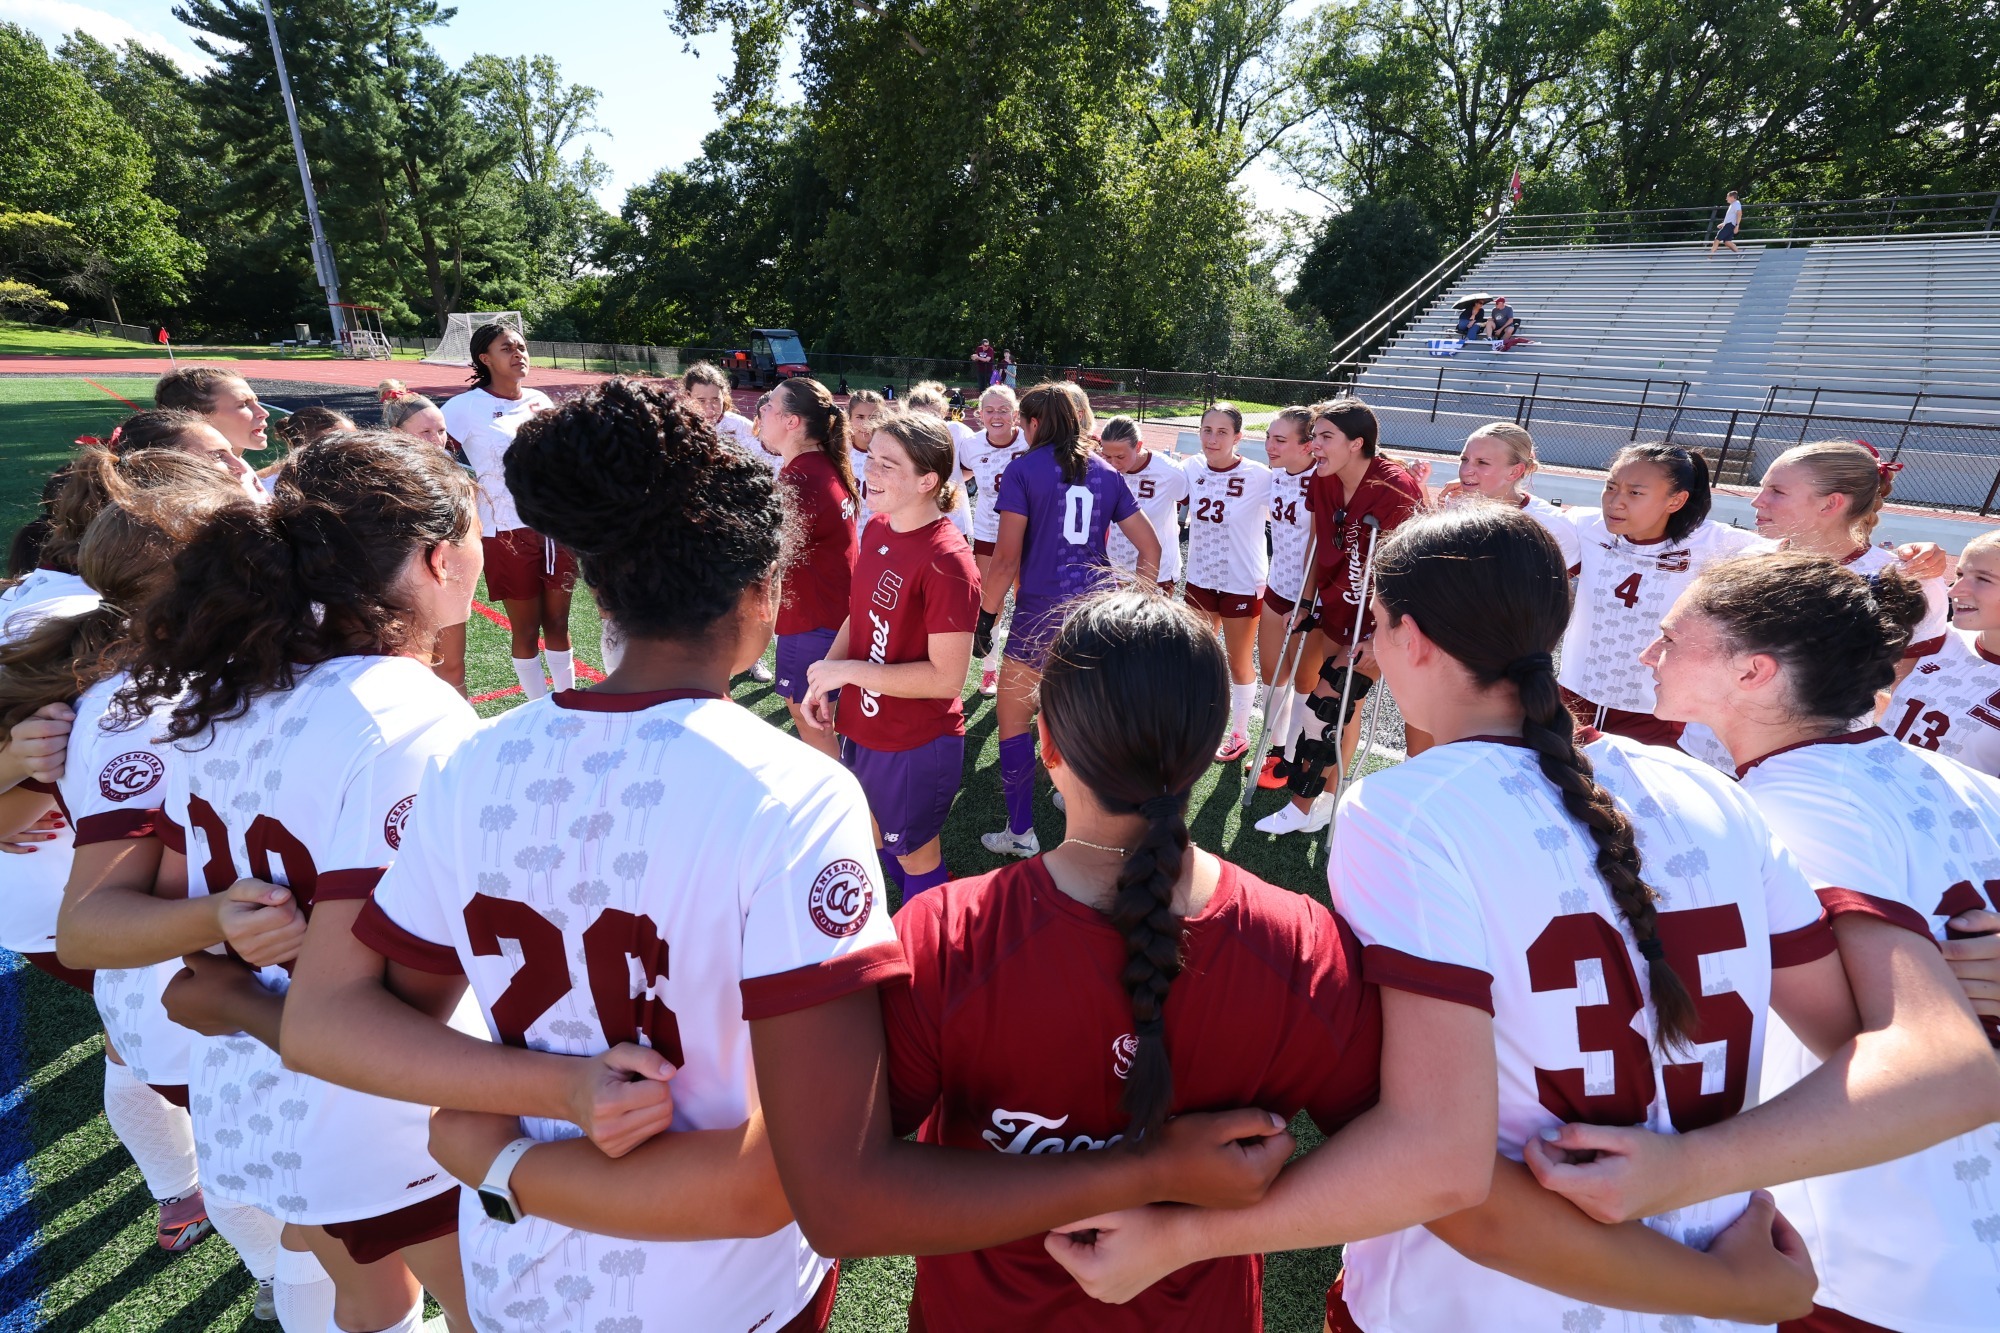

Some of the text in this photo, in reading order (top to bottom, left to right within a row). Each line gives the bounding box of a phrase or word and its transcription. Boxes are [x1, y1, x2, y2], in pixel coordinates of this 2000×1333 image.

[1137, 479, 1157, 499] S
[1225, 476, 1246, 498] S
[1063, 484, 1094, 545] 0
[1196, 497, 1226, 524] 23
[1272, 496, 1297, 526] 34
[1656, 548, 1692, 574] S
[872, 569, 903, 610] S
[1614, 572, 1643, 609] 4
[1893, 697, 1951, 752] 13
[102, 753, 162, 779] CENTENNIAL
[812, 862, 869, 904] CENTENNIAL
[826, 880, 860, 916] CC
[815, 896, 873, 933] CONFERENCE
[463, 891, 685, 1070] 26
[1525, 902, 1754, 1134] 35
